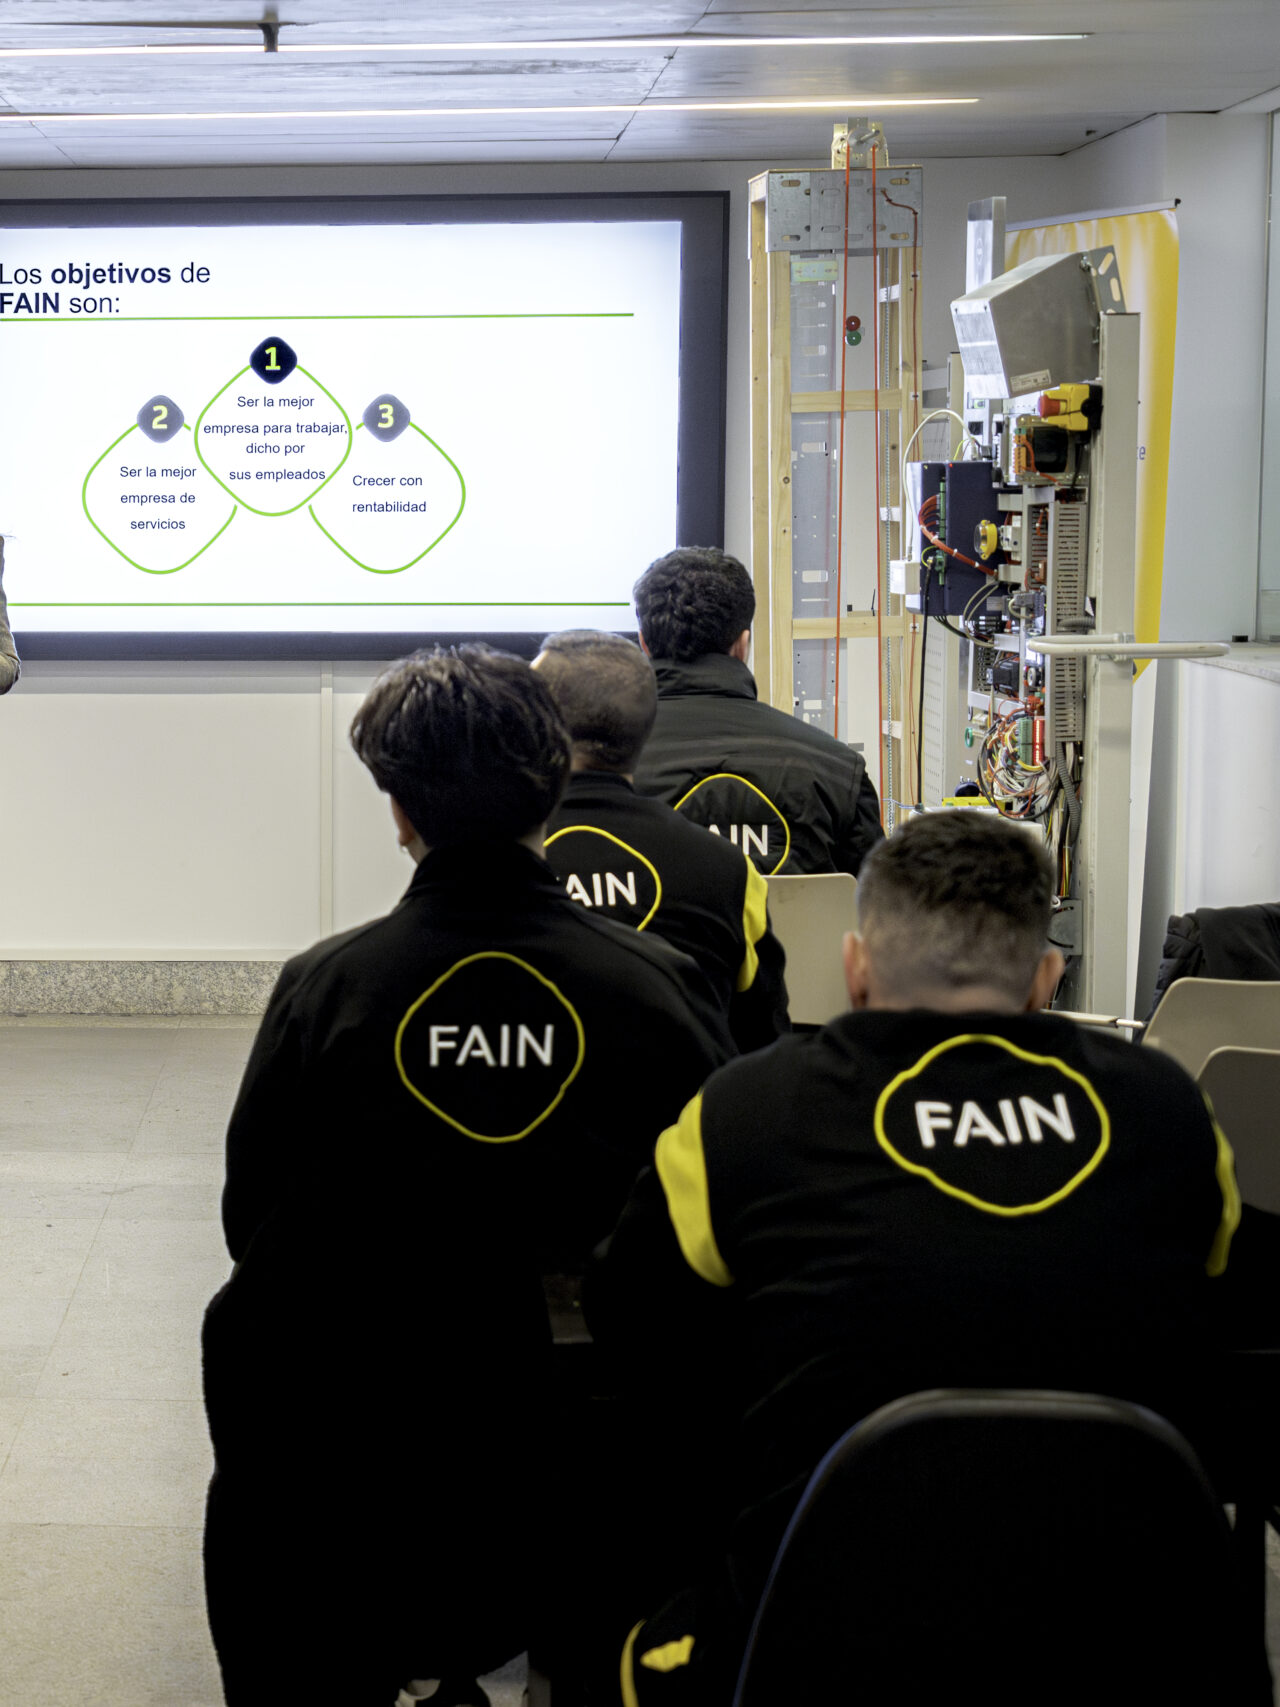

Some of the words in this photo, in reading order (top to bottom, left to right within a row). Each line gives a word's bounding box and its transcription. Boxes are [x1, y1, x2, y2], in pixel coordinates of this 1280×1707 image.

[0, 263, 42, 285] Los
[51, 262, 171, 290] objetivos
[180, 261, 211, 284] de
[0, 292, 60, 314] FAIN
[69, 296, 120, 314] son:
[265, 346, 281, 371] 1
[237, 396, 260, 408] Ser
[264, 396, 275, 408] la
[278, 395, 315, 410] mejor
[151, 405, 168, 430] 2
[377, 403, 394, 429] 3
[203, 424, 259, 437] empresa
[263, 424, 292, 437] para
[296, 422, 348, 437] trabajar,
[245, 442, 281, 454] dicho
[284, 445, 306, 457] por
[119, 466, 143, 478] Ser
[146, 466, 157, 478] la
[161, 466, 197, 481] mejor
[229, 471, 252, 481] sus
[255, 468, 326, 483] empleados
[352, 474, 397, 487] Crecer
[399, 477, 423, 487] con
[120, 494, 176, 507] empresa
[179, 492, 196, 504] de
[352, 501, 427, 513] rentabilidad
[130, 518, 186, 530] servicios
[565, 871, 637, 908] AIN
[428, 1023, 554, 1067] FAIN
[914, 1093, 1076, 1149] FAIN
